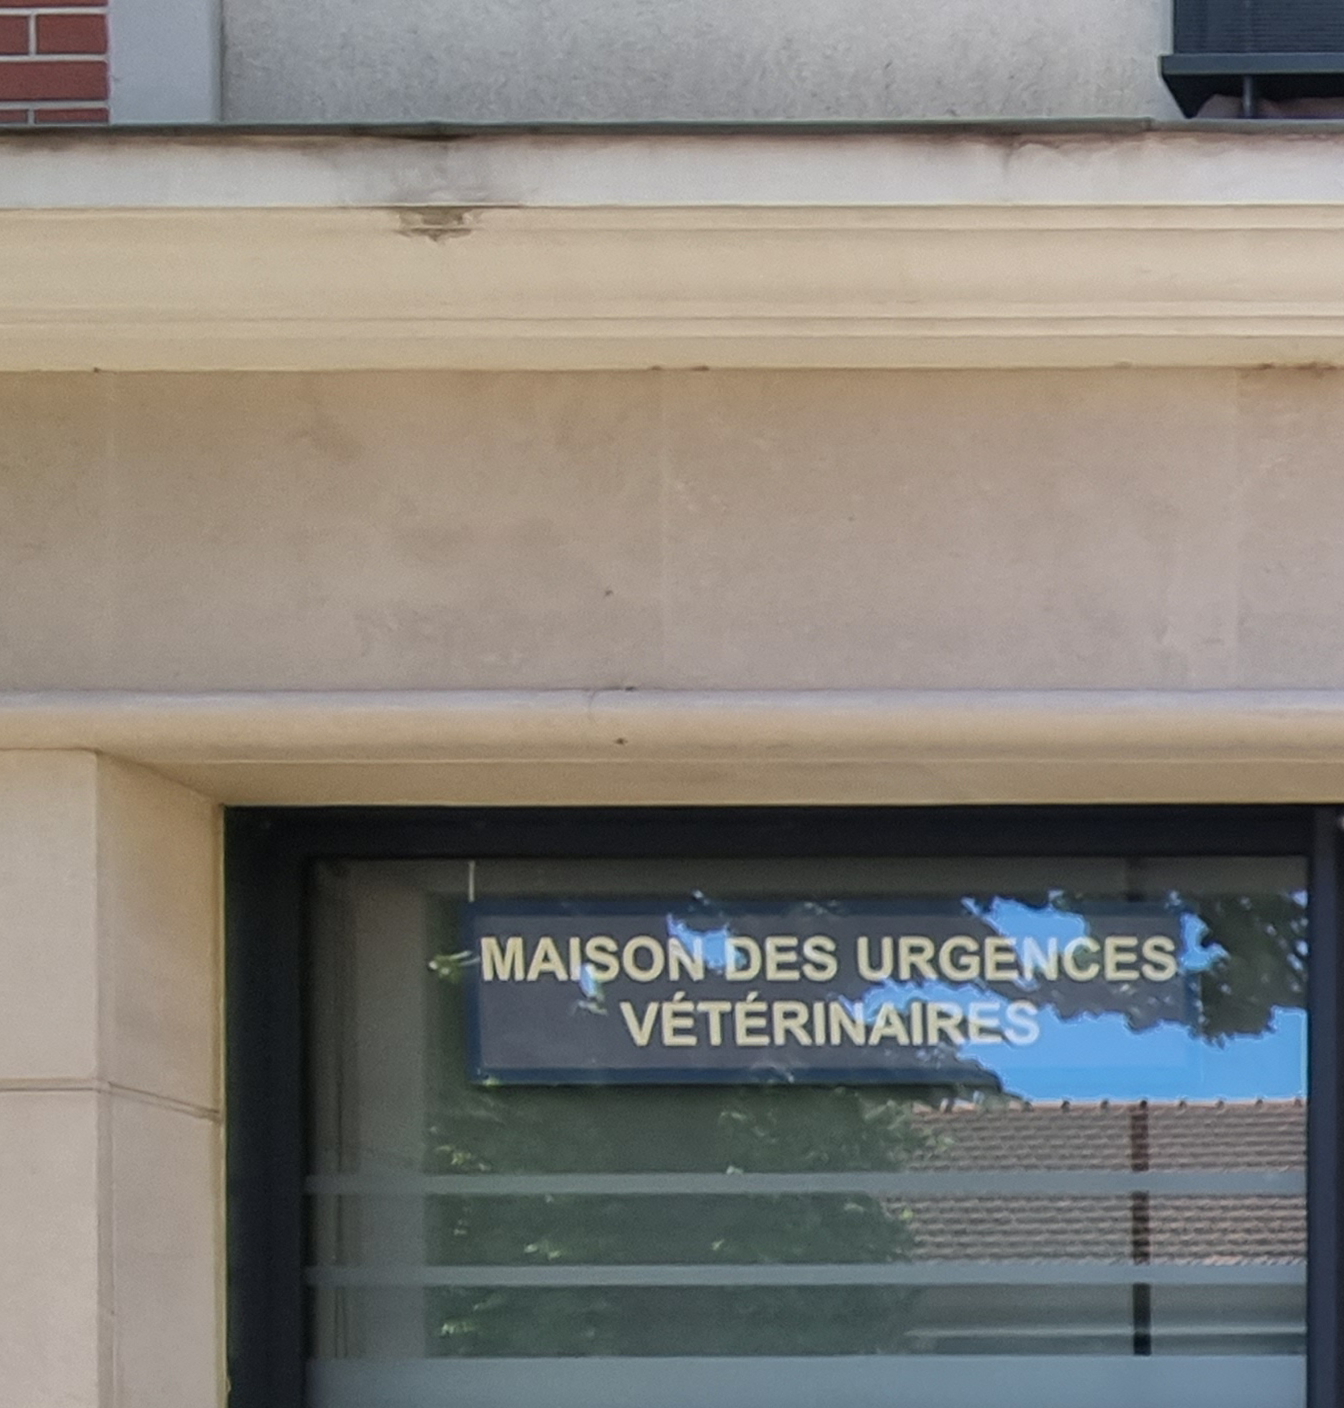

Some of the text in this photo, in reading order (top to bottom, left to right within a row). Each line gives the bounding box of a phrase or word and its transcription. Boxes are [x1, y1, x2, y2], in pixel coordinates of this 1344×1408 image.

[481, 935, 1178, 982] MAISON DES URGENCES
[618, 992, 1040, 1047] VÉTÉRINAIRES
